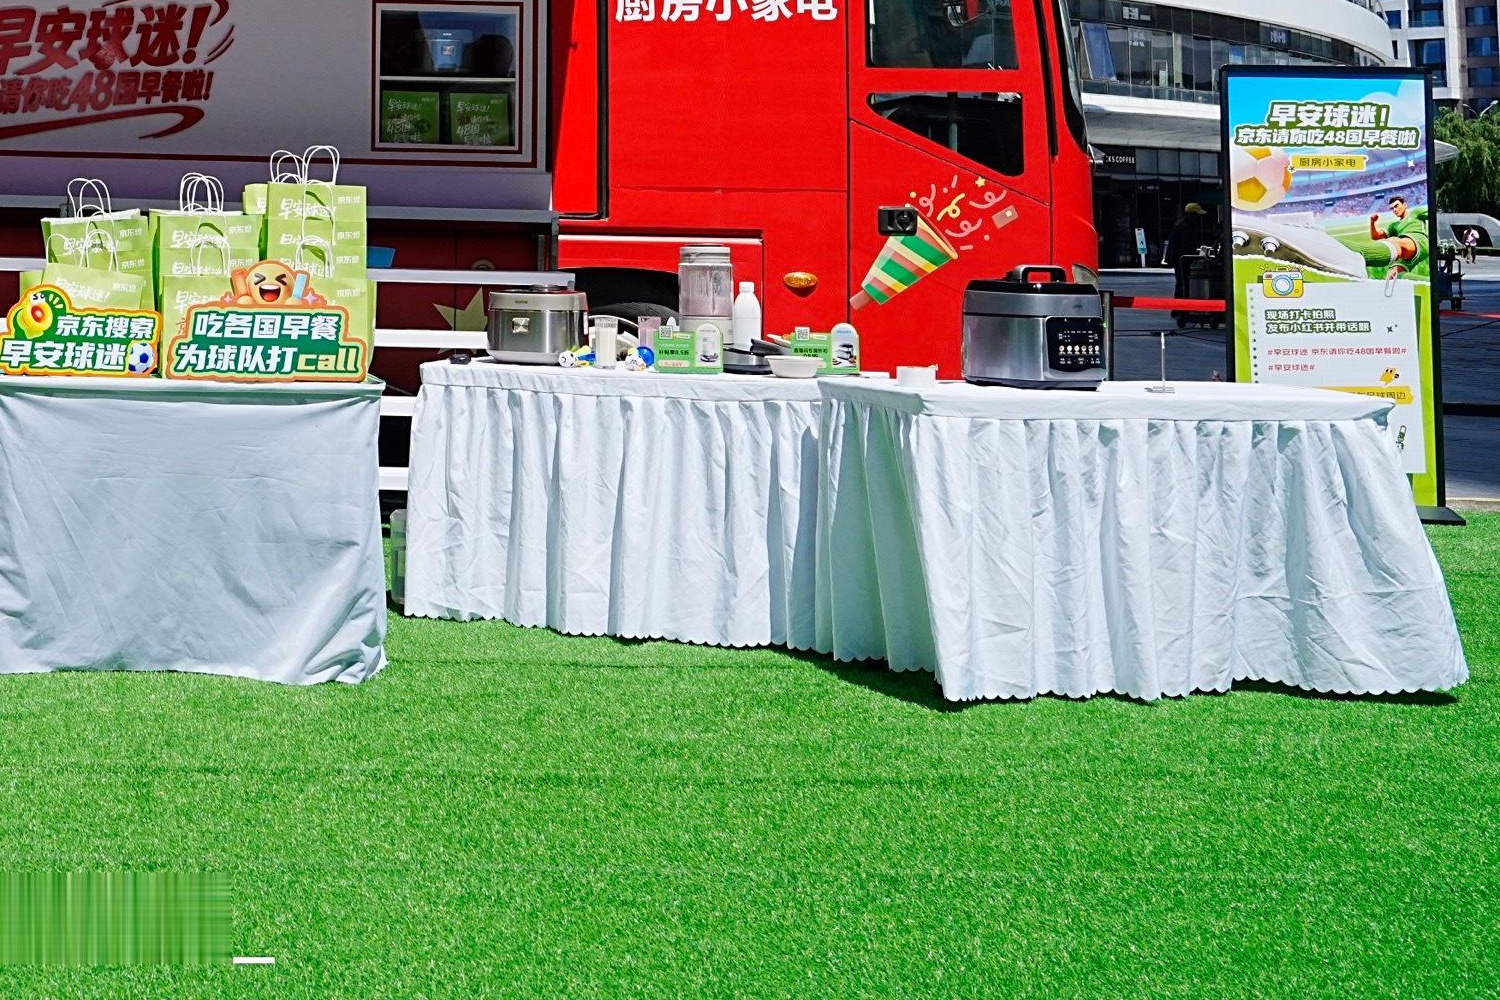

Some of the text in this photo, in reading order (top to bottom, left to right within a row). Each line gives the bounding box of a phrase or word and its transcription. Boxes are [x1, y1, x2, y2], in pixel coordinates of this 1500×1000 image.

[1269, 104, 1389, 127] 早安球迷!
[1236, 128, 1418, 148] 京东请你吃48国早餐啦
[1116, 156, 1135, 164] COFFEE
[1298, 157, 1357, 168] 厨房小家电
[1265, 309, 1335, 321] 现场打卡拍照
[56, 316, 154, 339] 京东搜索
[194, 313, 340, 340] 吃各国早餐
[1266, 322, 1371, 333] 发布小红书并带话题
[0, 340, 127, 371] 早安球迷
[176, 344, 358, 373] 为球队打call
